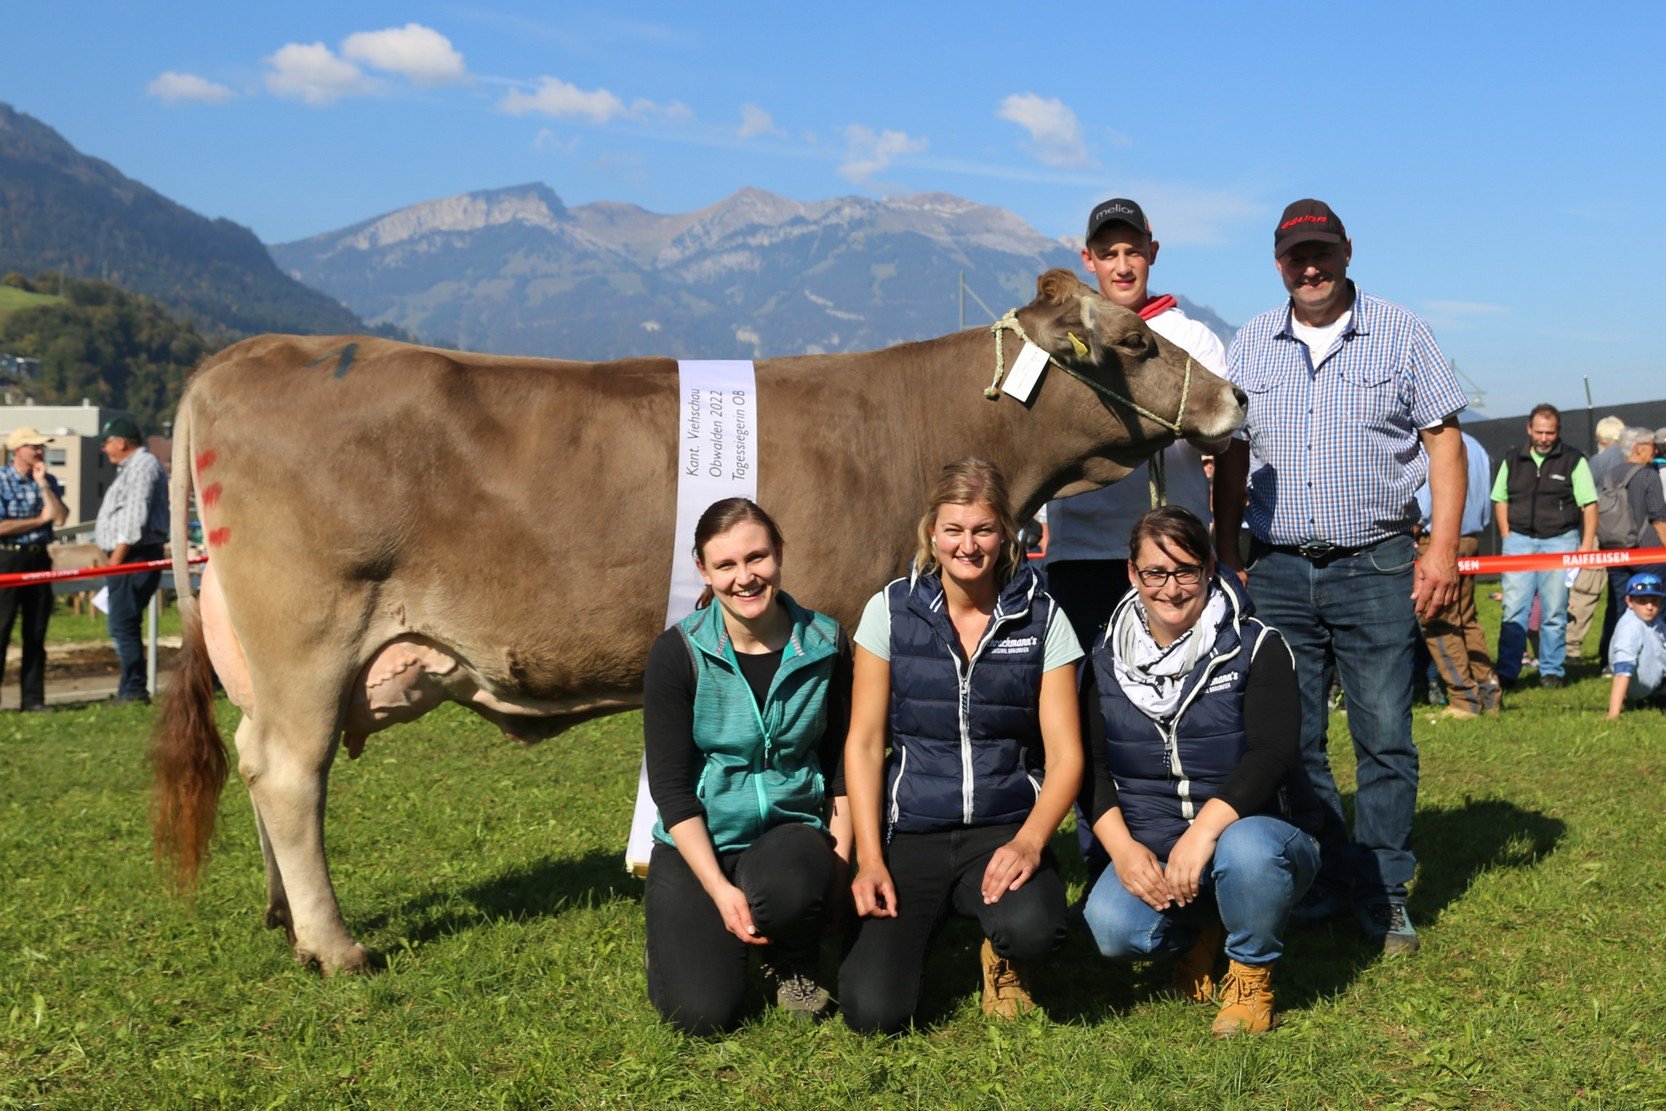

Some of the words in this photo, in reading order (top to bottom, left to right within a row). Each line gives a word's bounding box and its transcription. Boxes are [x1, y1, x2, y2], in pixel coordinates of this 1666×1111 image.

[1096, 203, 1135, 220] melior
[710, 390, 723, 418] 2022
[732, 390, 745, 406] OB
[687, 388, 700, 439] Viehschau
[709, 420, 723, 478] Obwalden
[732, 409, 749, 481] Tagessiegerin
[686, 445, 700, 477] Kant.
[1562, 552, 1630, 566] RAIFFEISEN
